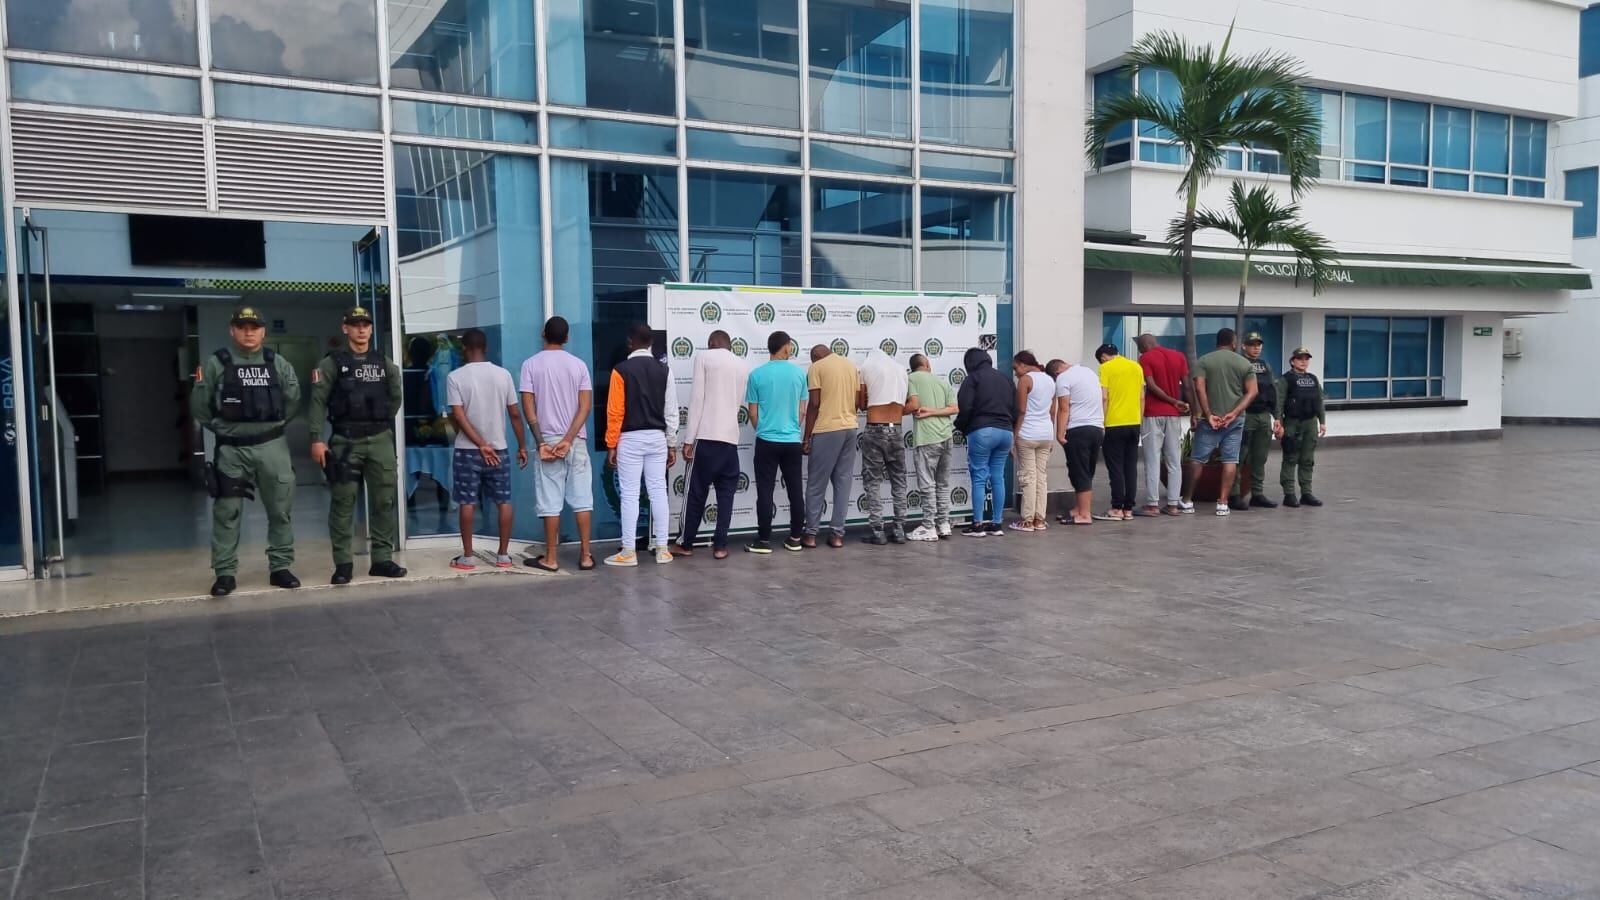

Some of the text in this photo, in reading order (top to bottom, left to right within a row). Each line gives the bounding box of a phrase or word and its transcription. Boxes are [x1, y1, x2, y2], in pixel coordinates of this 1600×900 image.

[1303, 265, 1354, 283] NAONAL
[238, 367, 270, 378] GAULA
[355, 368, 386, 378] GAULA
